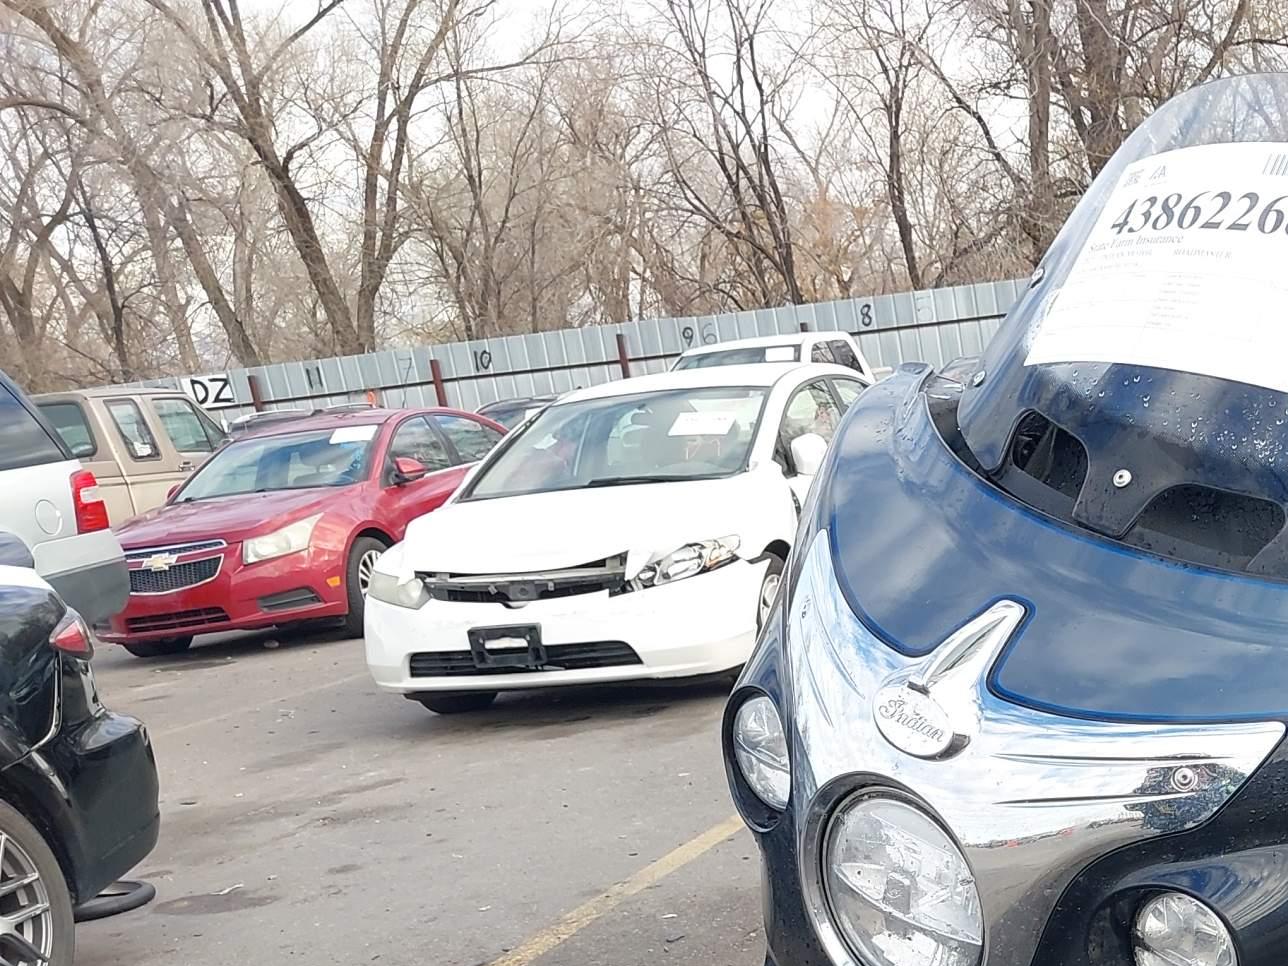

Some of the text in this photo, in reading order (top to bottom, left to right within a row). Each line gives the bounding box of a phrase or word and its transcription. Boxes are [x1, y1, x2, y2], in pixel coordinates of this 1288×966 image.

[859, 303, 873, 327] 8
[474, 350, 492, 373] 10
[190, 378, 236, 405] DZ
[878, 697, 944, 743] Indian
